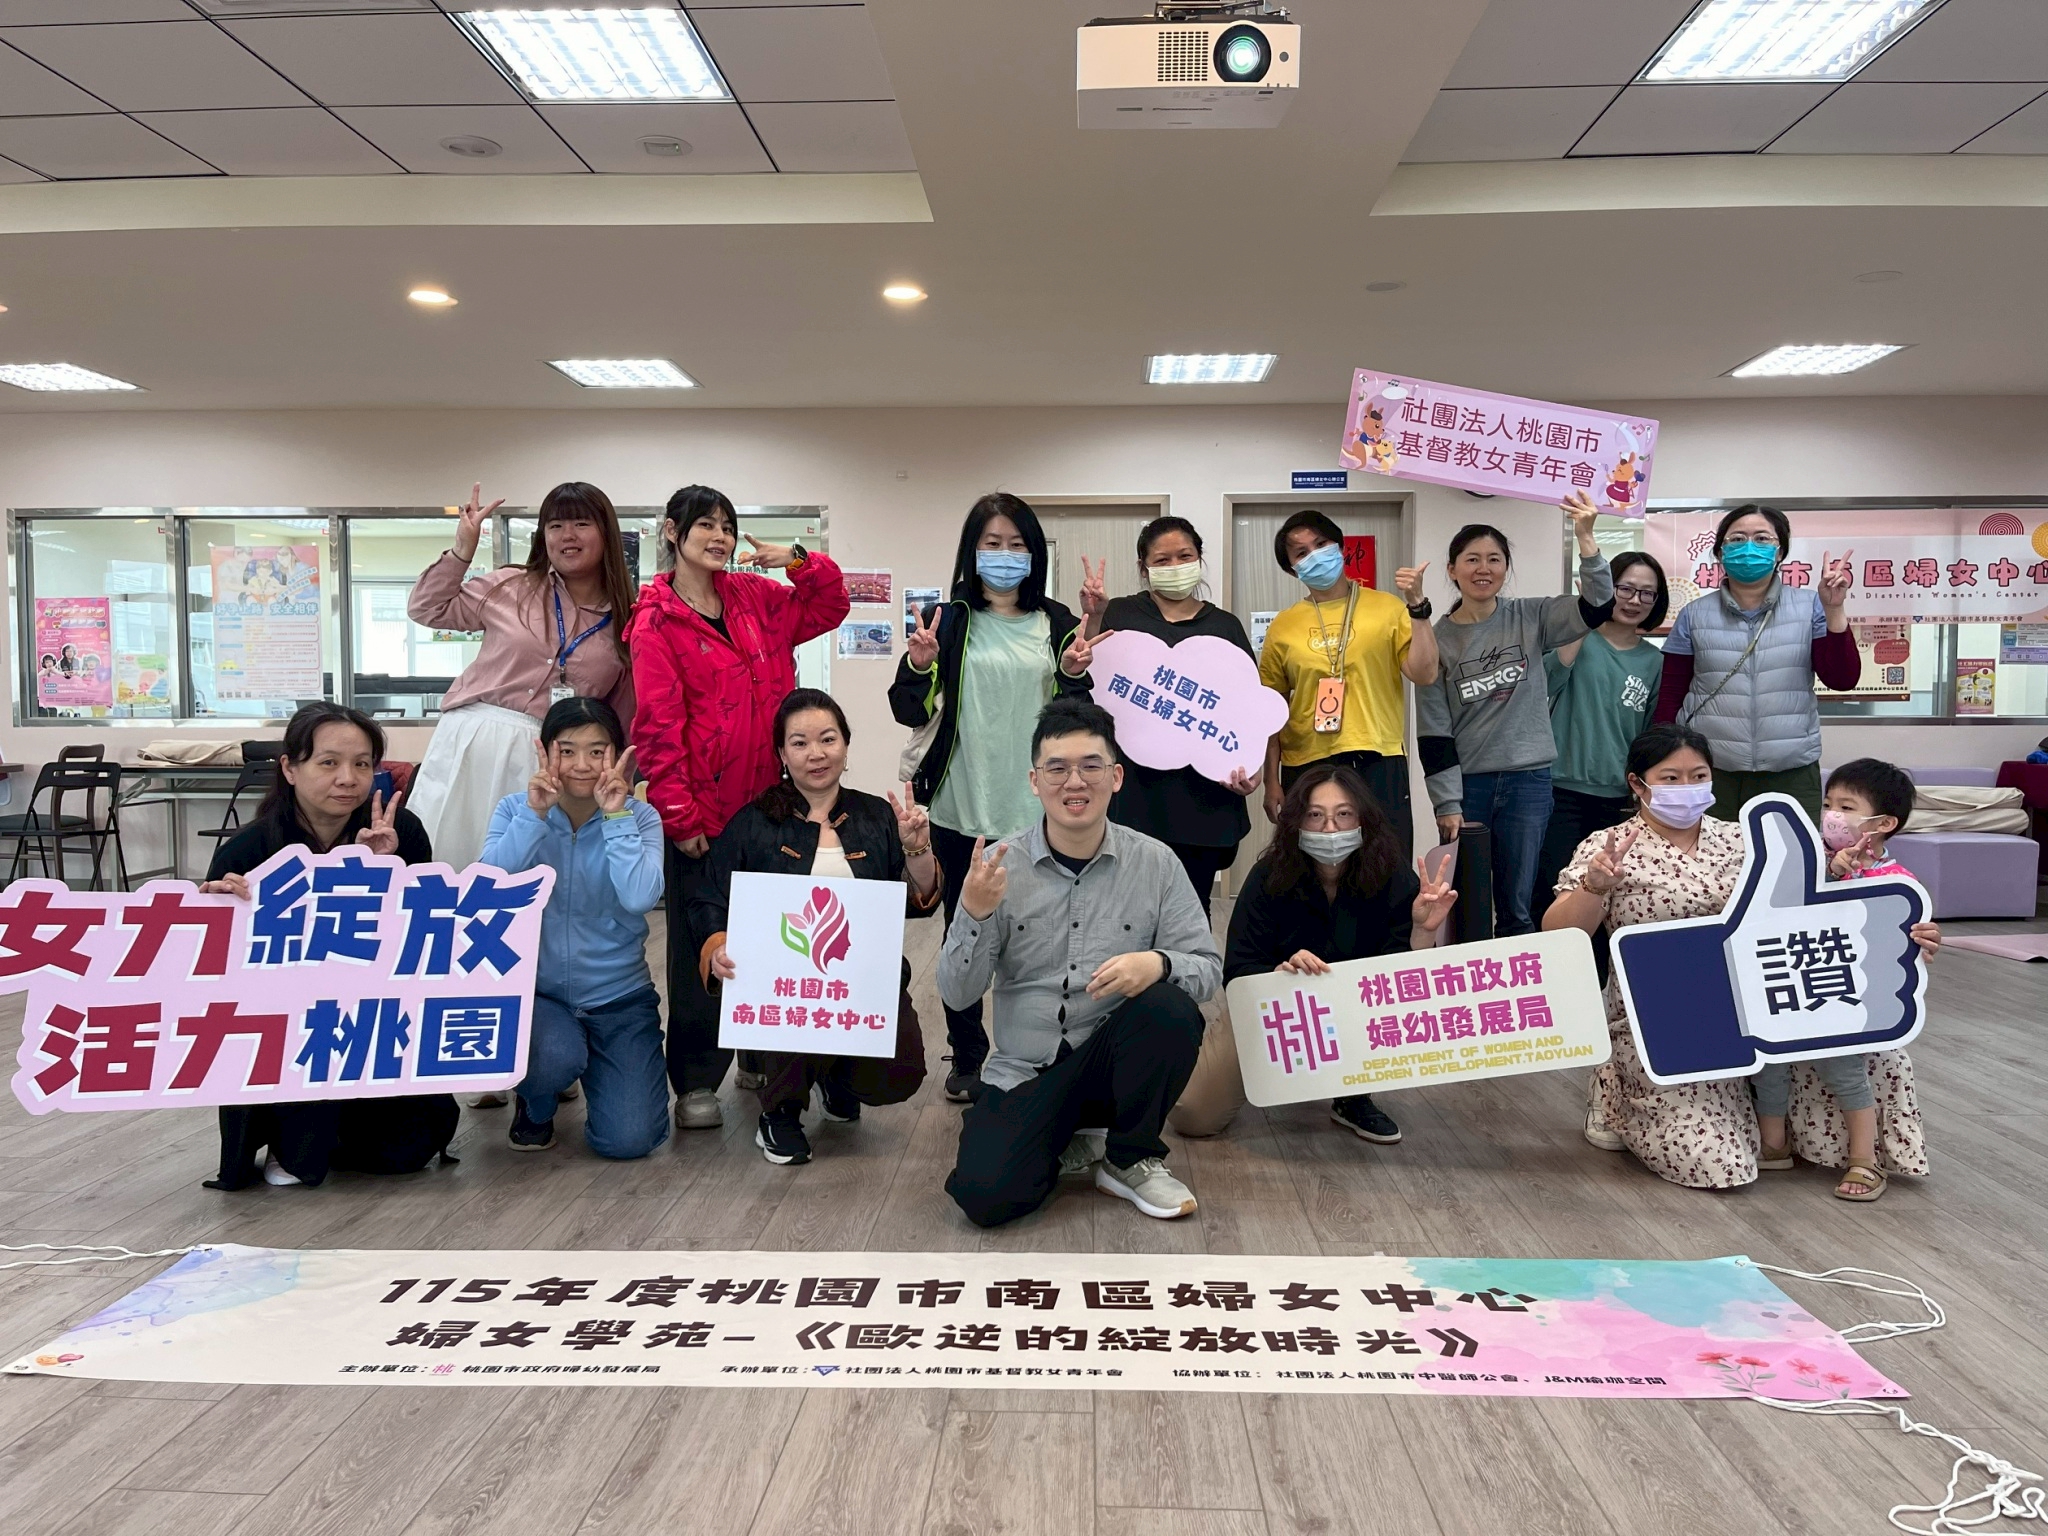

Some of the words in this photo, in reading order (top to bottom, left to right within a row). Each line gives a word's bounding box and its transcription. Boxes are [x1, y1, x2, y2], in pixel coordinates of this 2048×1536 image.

[1400, 396, 1603, 455] 社團法人桃園市
[1395, 430, 1598, 489] 基督教女青年會
[1694, 558, 2048, 590] 桃市區婦女中心
[270, 602, 319, 616] 安全相伴
[1153, 664, 1221, 711] 桃園市
[1107, 673, 1240, 753] 南區婦女中心
[0, 855, 545, 977] 女力綻放
[773, 977, 849, 1001] 桃園市
[1357, 952, 1544, 1008] 桃園市政府
[1756, 927, 1862, 1016] 讚
[732, 1003, 886, 1031] 南區婦女中心
[1365, 994, 1554, 1051] 婦幼發展局
[34, 994, 522, 1097] 活力桃園
[1363, 1049, 1454, 1071] DEPARTMENT
[1459, 1045, 1480, 1058] OF
[1483, 1038, 1534, 1055] WOMEN
[1534, 1034, 1565, 1049] AND
[1342, 1067, 1413, 1086] CHILDREN
[380, 1274, 1539, 1312] 115年度桃園市南區婦女中心
[462, 1365, 662, 1375] 桃園市政府婦幼發展局
[846, 1366, 1125, 1378] 社團法人桃園市基督教女青年會
